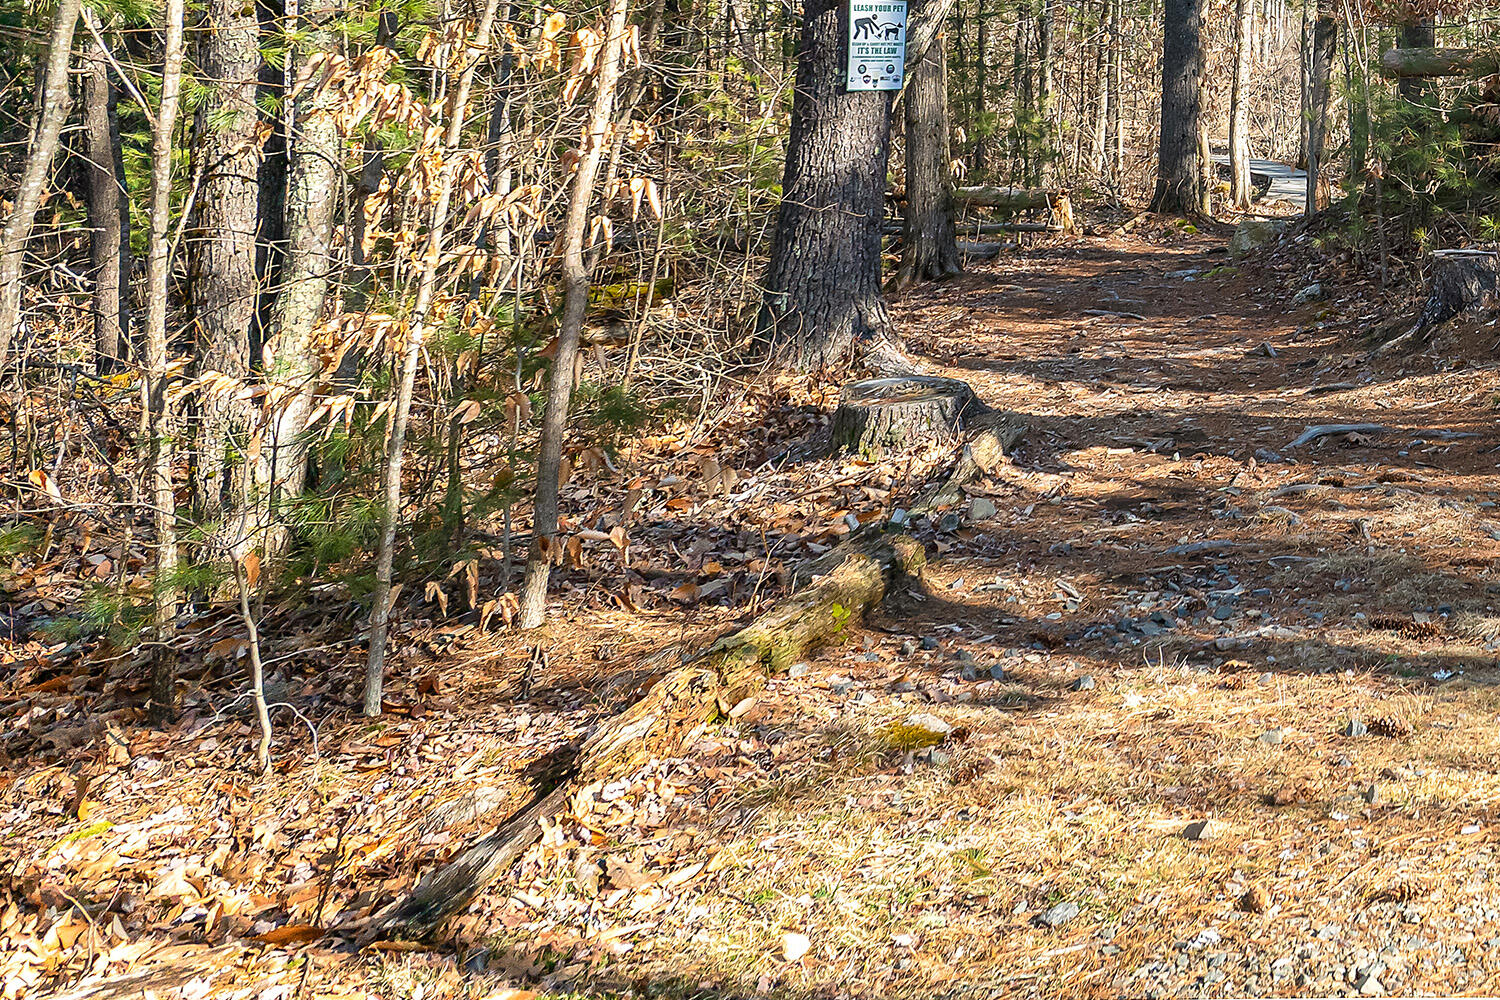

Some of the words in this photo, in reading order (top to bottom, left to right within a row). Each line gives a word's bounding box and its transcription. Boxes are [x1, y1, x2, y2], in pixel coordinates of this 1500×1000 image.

[853, 4, 873, 12] LEASH
[874, 4, 892, 12] YOUR
[893, 4, 904, 13] PET
[883, 47, 898, 55] LAW
